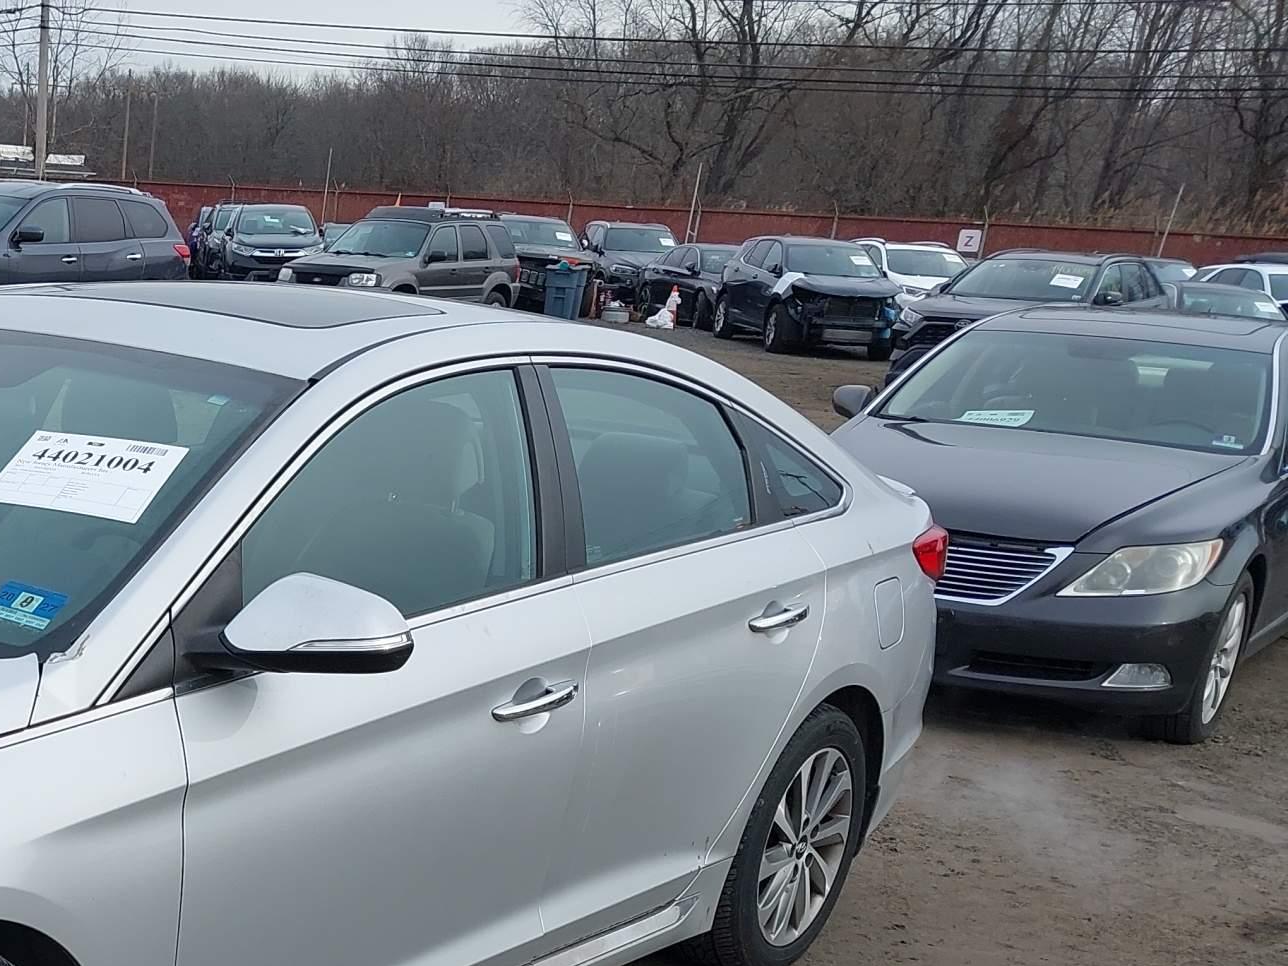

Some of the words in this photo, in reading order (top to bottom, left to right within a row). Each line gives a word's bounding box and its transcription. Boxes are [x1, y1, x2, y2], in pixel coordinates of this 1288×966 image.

[963, 235, 974, 247] Z
[32, 447, 156, 475] 44021004
[0, 591, 15, 601] 20
[20, 595, 35, 608] 9
